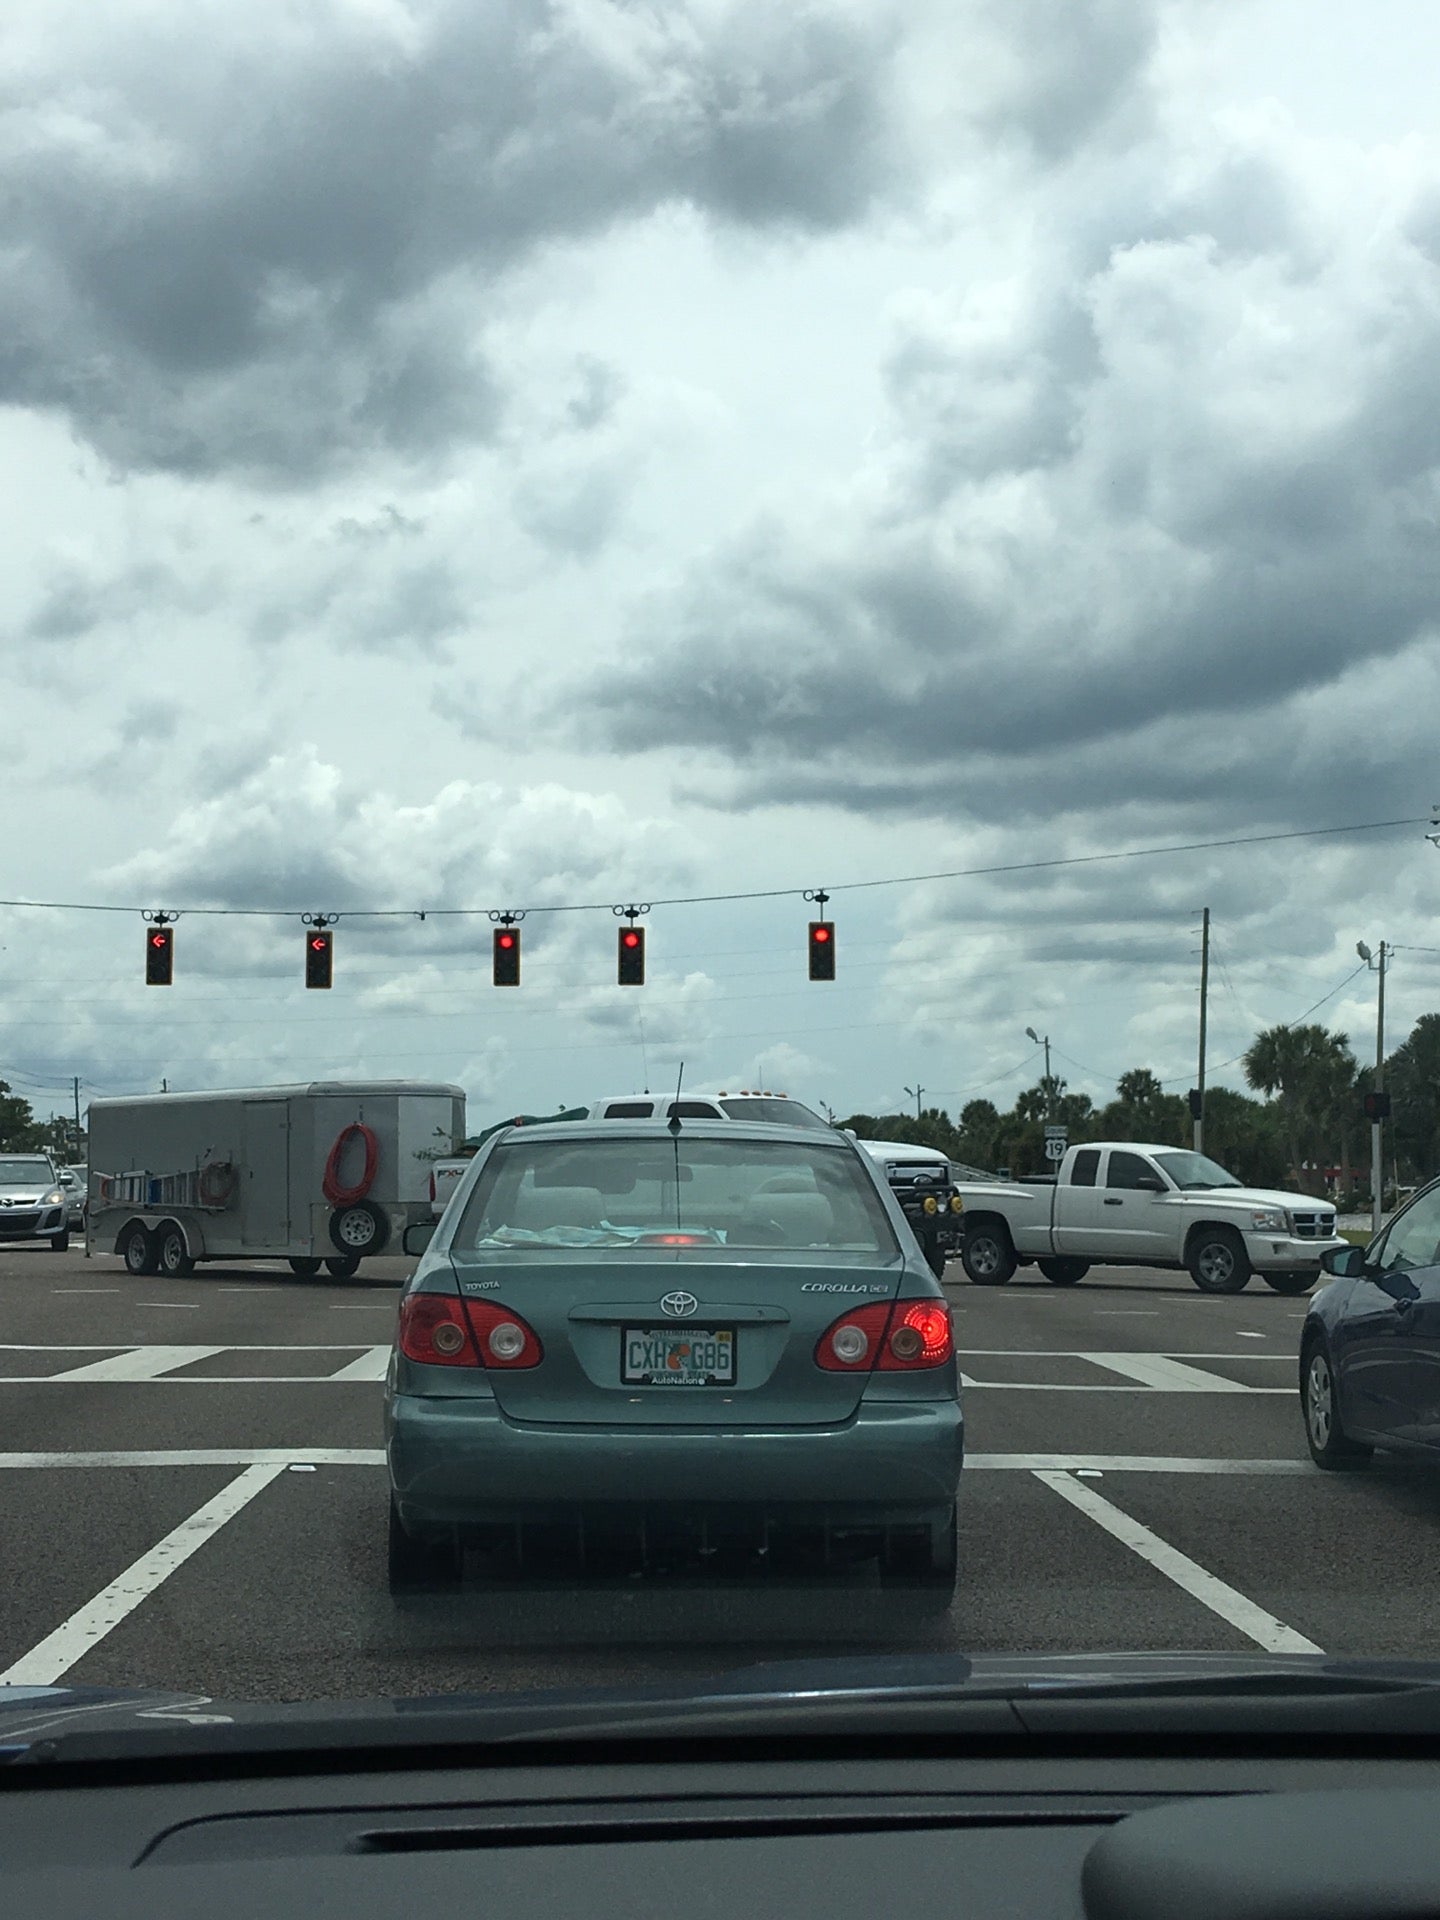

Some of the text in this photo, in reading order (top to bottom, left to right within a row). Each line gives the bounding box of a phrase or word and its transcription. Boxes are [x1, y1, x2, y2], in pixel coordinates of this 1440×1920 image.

[1050, 1143, 1063, 1156] 19
[438, 1169, 465, 1178] FX4
[465, 1281, 500, 1291] TOYOTA
[801, 1283, 868, 1293] COROLLA
[629, 1341, 667, 1369] CXH
[651, 1377, 698, 1385] AutoNation
